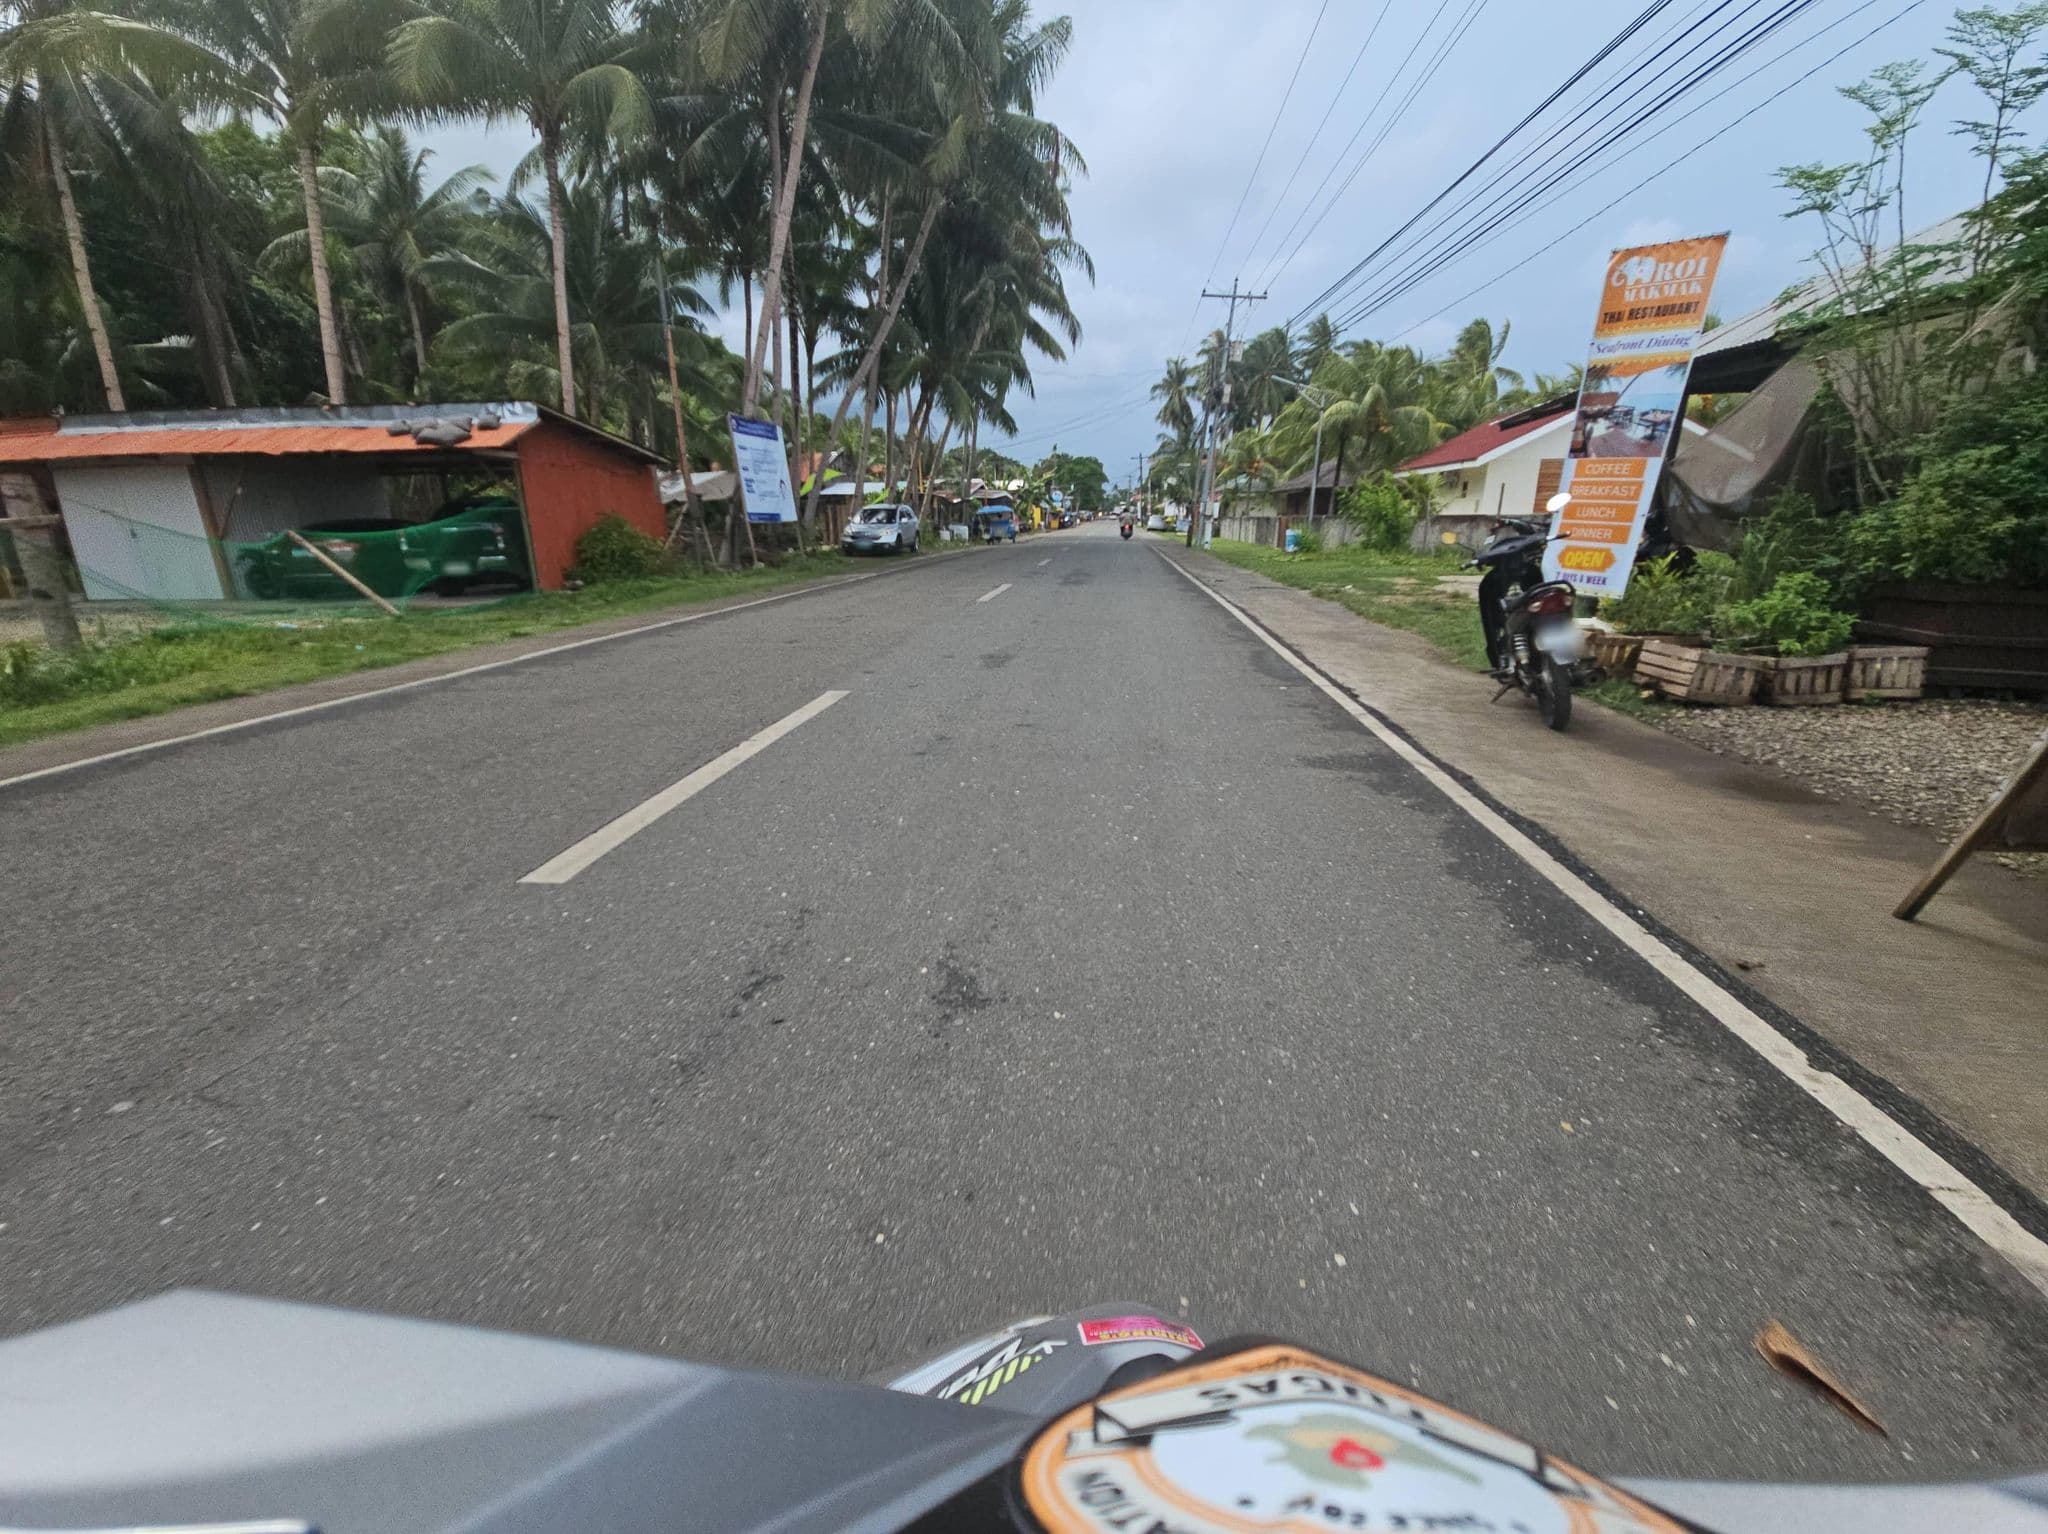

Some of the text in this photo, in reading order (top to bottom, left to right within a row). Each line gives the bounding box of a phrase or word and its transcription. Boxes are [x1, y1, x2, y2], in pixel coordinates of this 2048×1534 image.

[1628, 302, 1700, 320] RESTAURANT
[1595, 334, 1692, 354] Seafront Dining
[1585, 463, 1631, 475] COFFEE
[1571, 484, 1638, 497] BREAKFAST
[1577, 507, 1616, 519] LUNCH
[1570, 526, 1615, 539] DINNER
[1566, 551, 1606, 567] OPEN
[1586, 576, 1608, 585] WEEK
